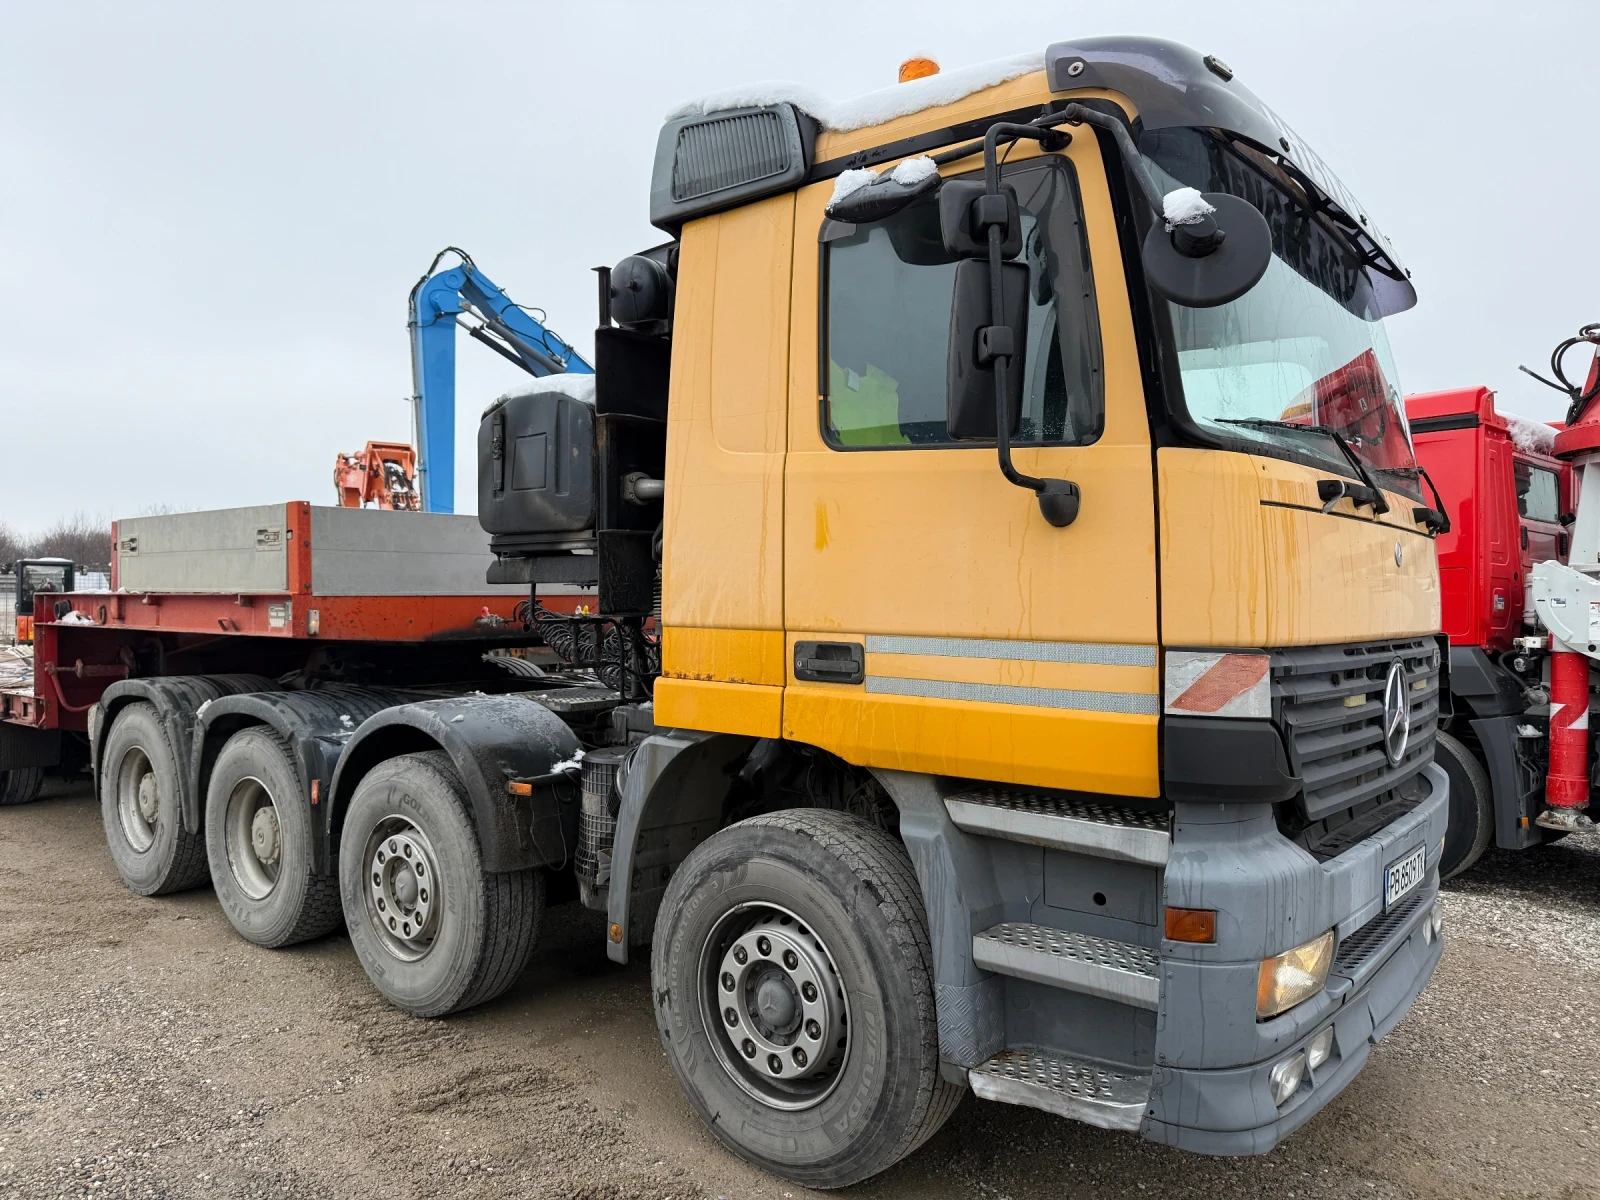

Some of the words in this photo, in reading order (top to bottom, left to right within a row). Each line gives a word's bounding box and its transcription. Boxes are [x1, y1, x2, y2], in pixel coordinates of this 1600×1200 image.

[403, 793, 443, 844] GOLDEN
[1390, 868, 1400, 900] PB
[671, 892, 707, 1028] REGIOCONTROL
[833, 1040, 877, 1133] FULDA
